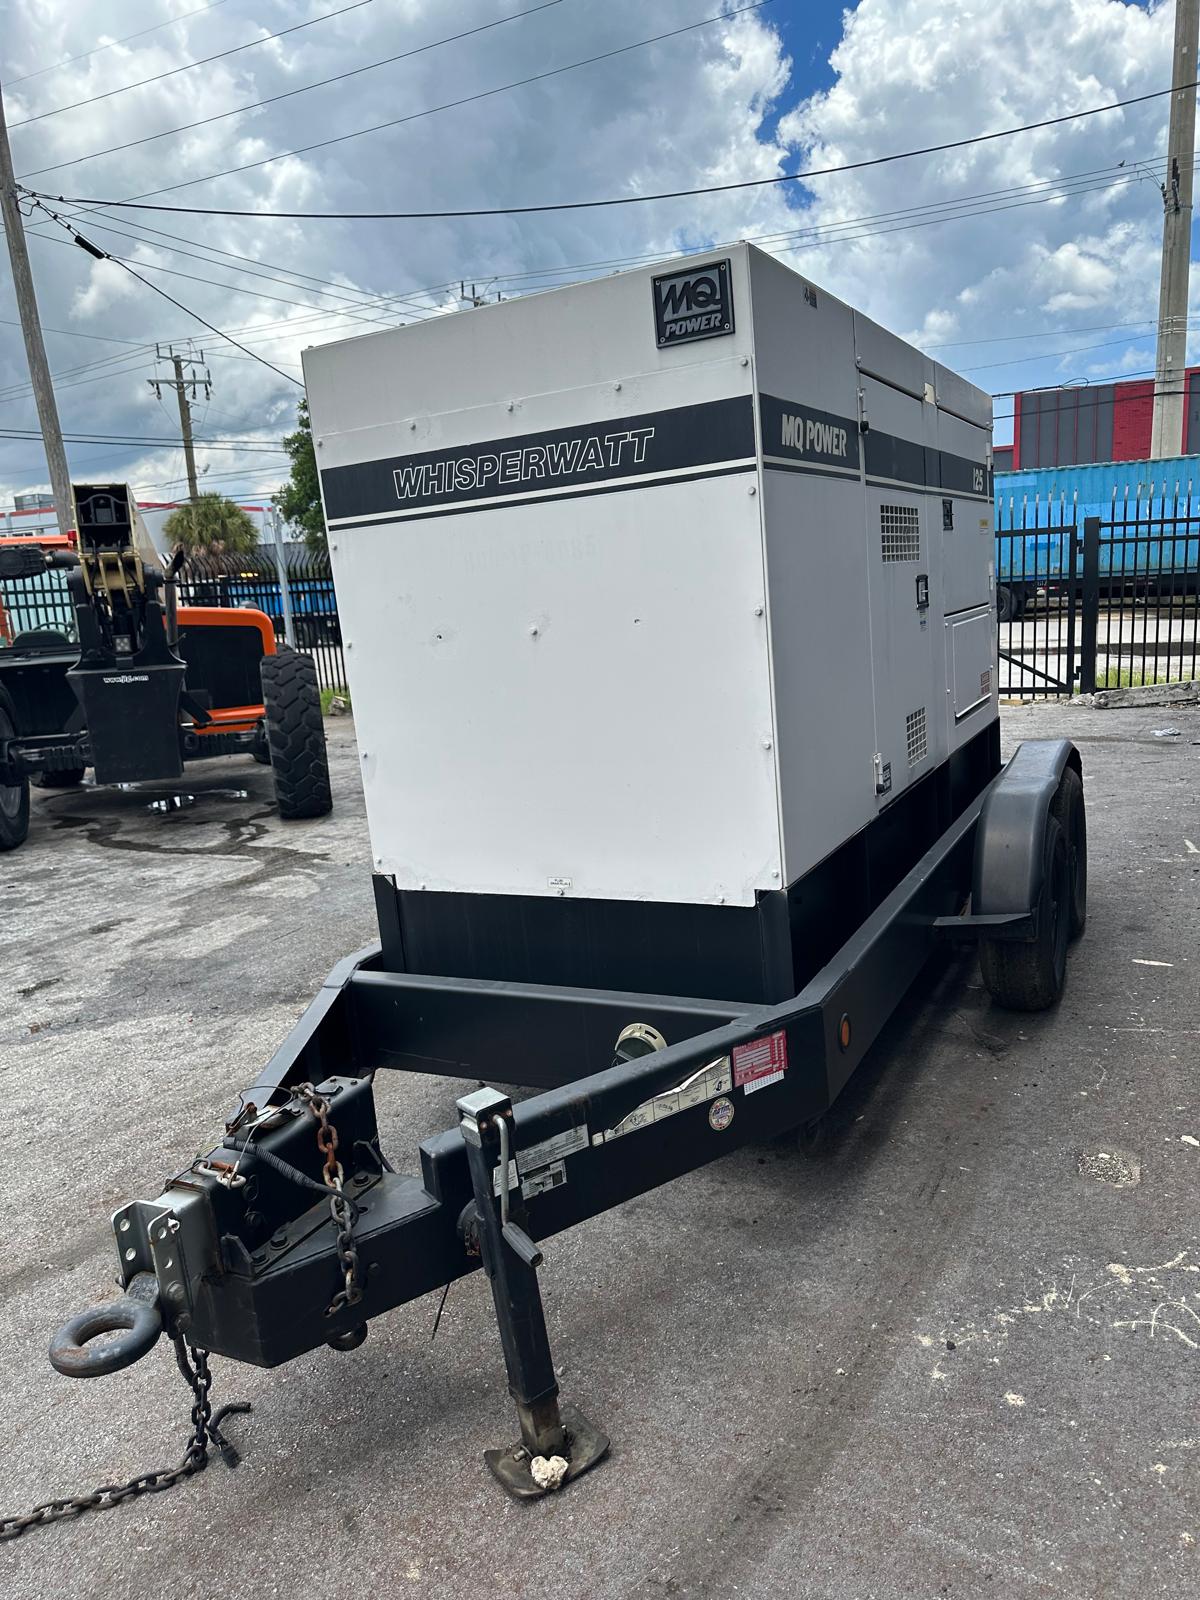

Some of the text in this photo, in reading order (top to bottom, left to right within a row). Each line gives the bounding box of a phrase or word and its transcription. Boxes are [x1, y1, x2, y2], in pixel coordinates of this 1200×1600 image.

[662, 276, 720, 315] MQ
[665, 312, 722, 338] POWER
[781, 413, 847, 457] MQ POWER
[393, 427, 655, 500] WHISPERWATT
[972, 467, 984, 491] 125
